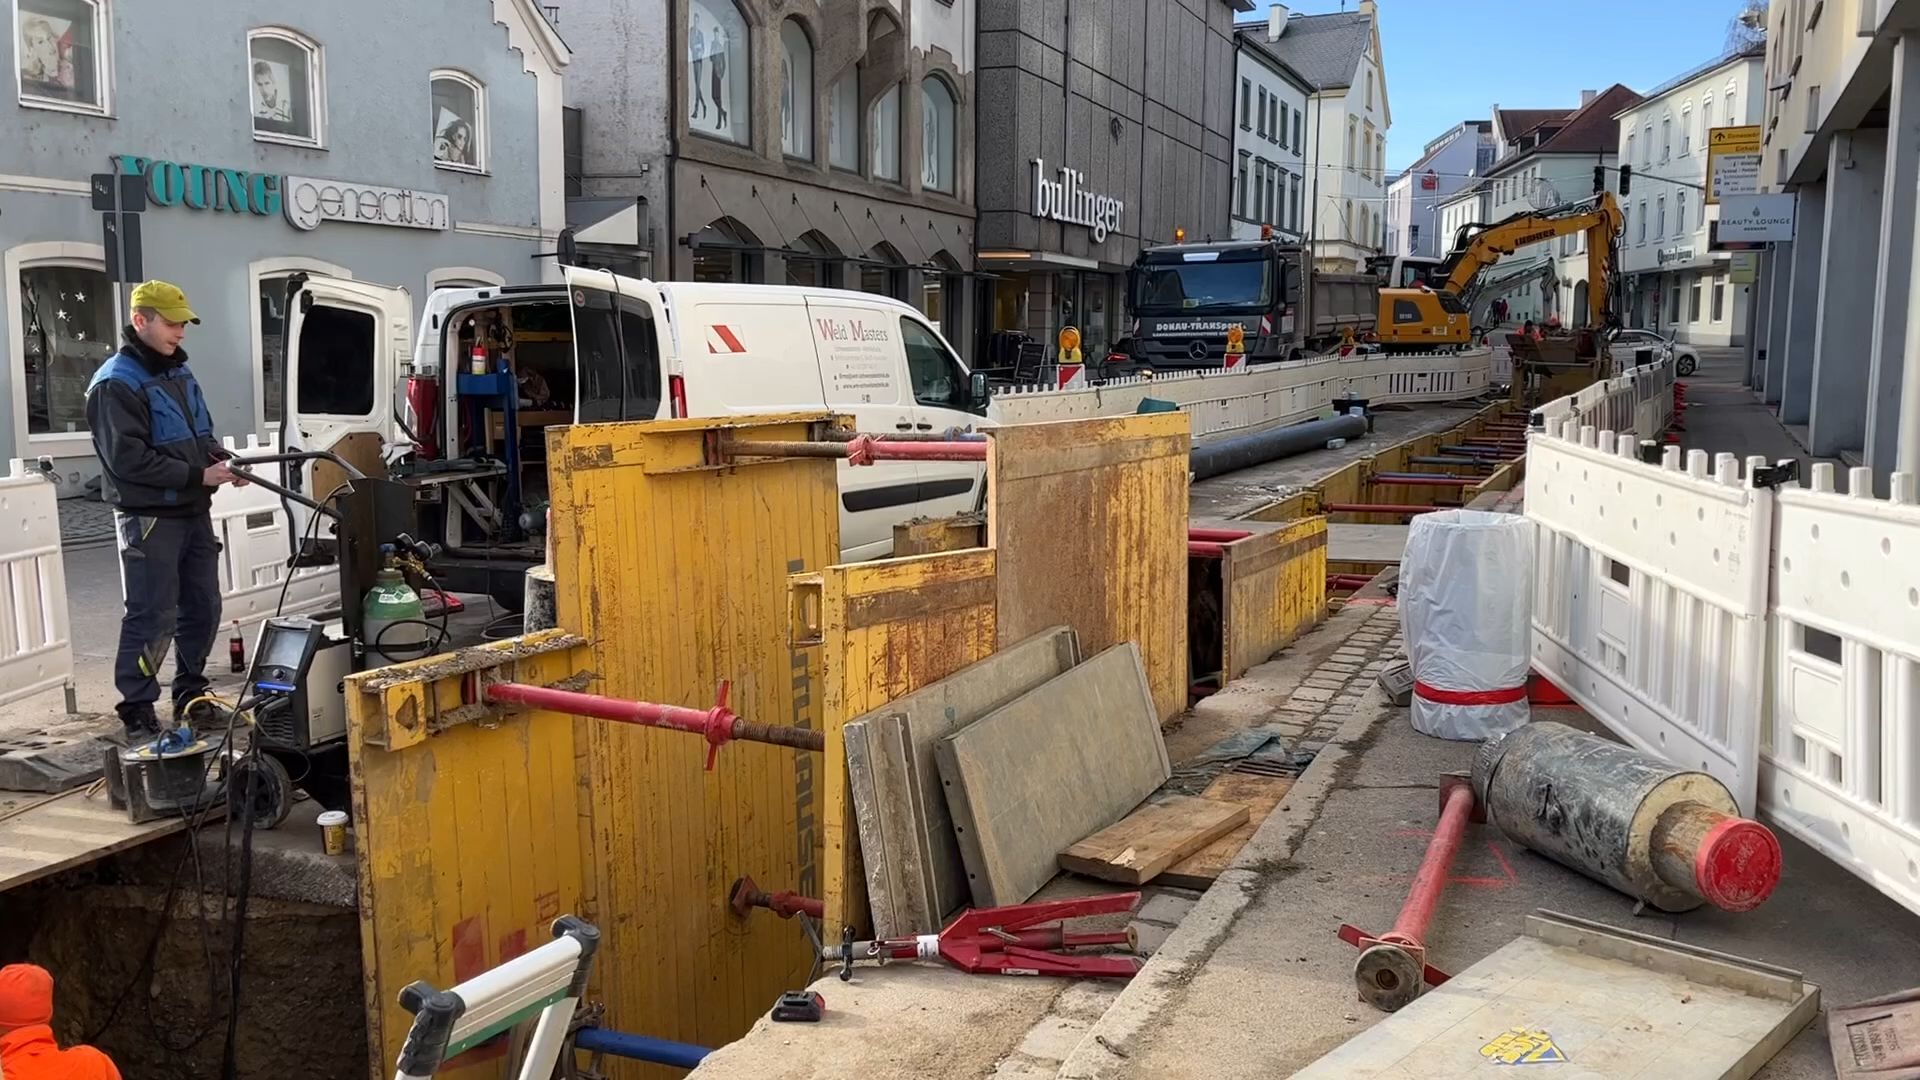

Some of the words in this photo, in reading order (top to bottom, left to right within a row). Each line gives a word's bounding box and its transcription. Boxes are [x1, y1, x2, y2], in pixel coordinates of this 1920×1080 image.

[110, 154, 280, 215] YOUNG
[295, 183, 446, 228] generation
[1035, 158, 1124, 243] bullinger
[1514, 228, 1556, 246] LIEBHERR
[816, 318, 848, 341] Weld
[849, 320, 889, 342] Masters
